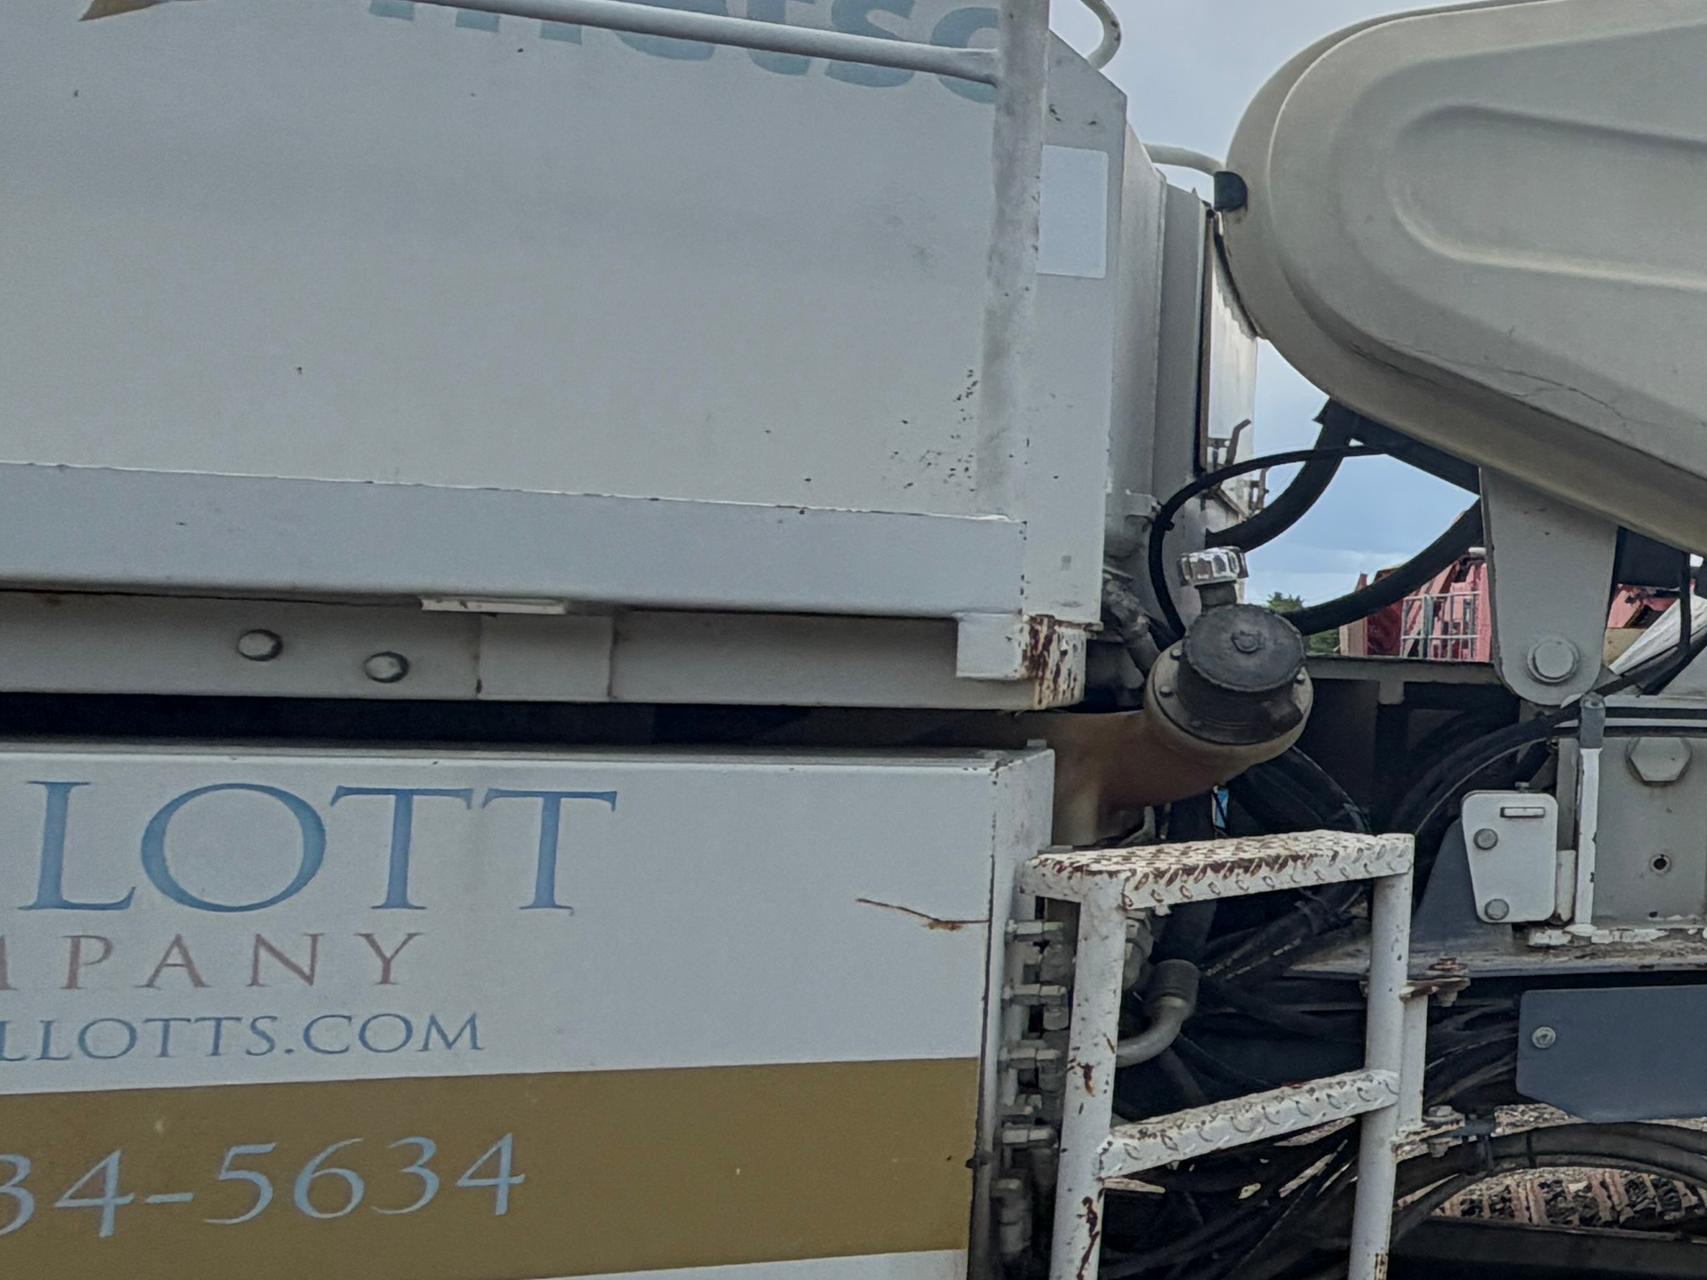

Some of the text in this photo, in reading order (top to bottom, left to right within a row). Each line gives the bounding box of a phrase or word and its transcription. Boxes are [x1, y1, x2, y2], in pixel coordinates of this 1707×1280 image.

[18, 780, 618, 915] LOTT
[0, 931, 426, 991] PANY
[0, 1011, 485, 1063] LLOTTS.COM
[0, 1131, 525, 1239] 34-5634
